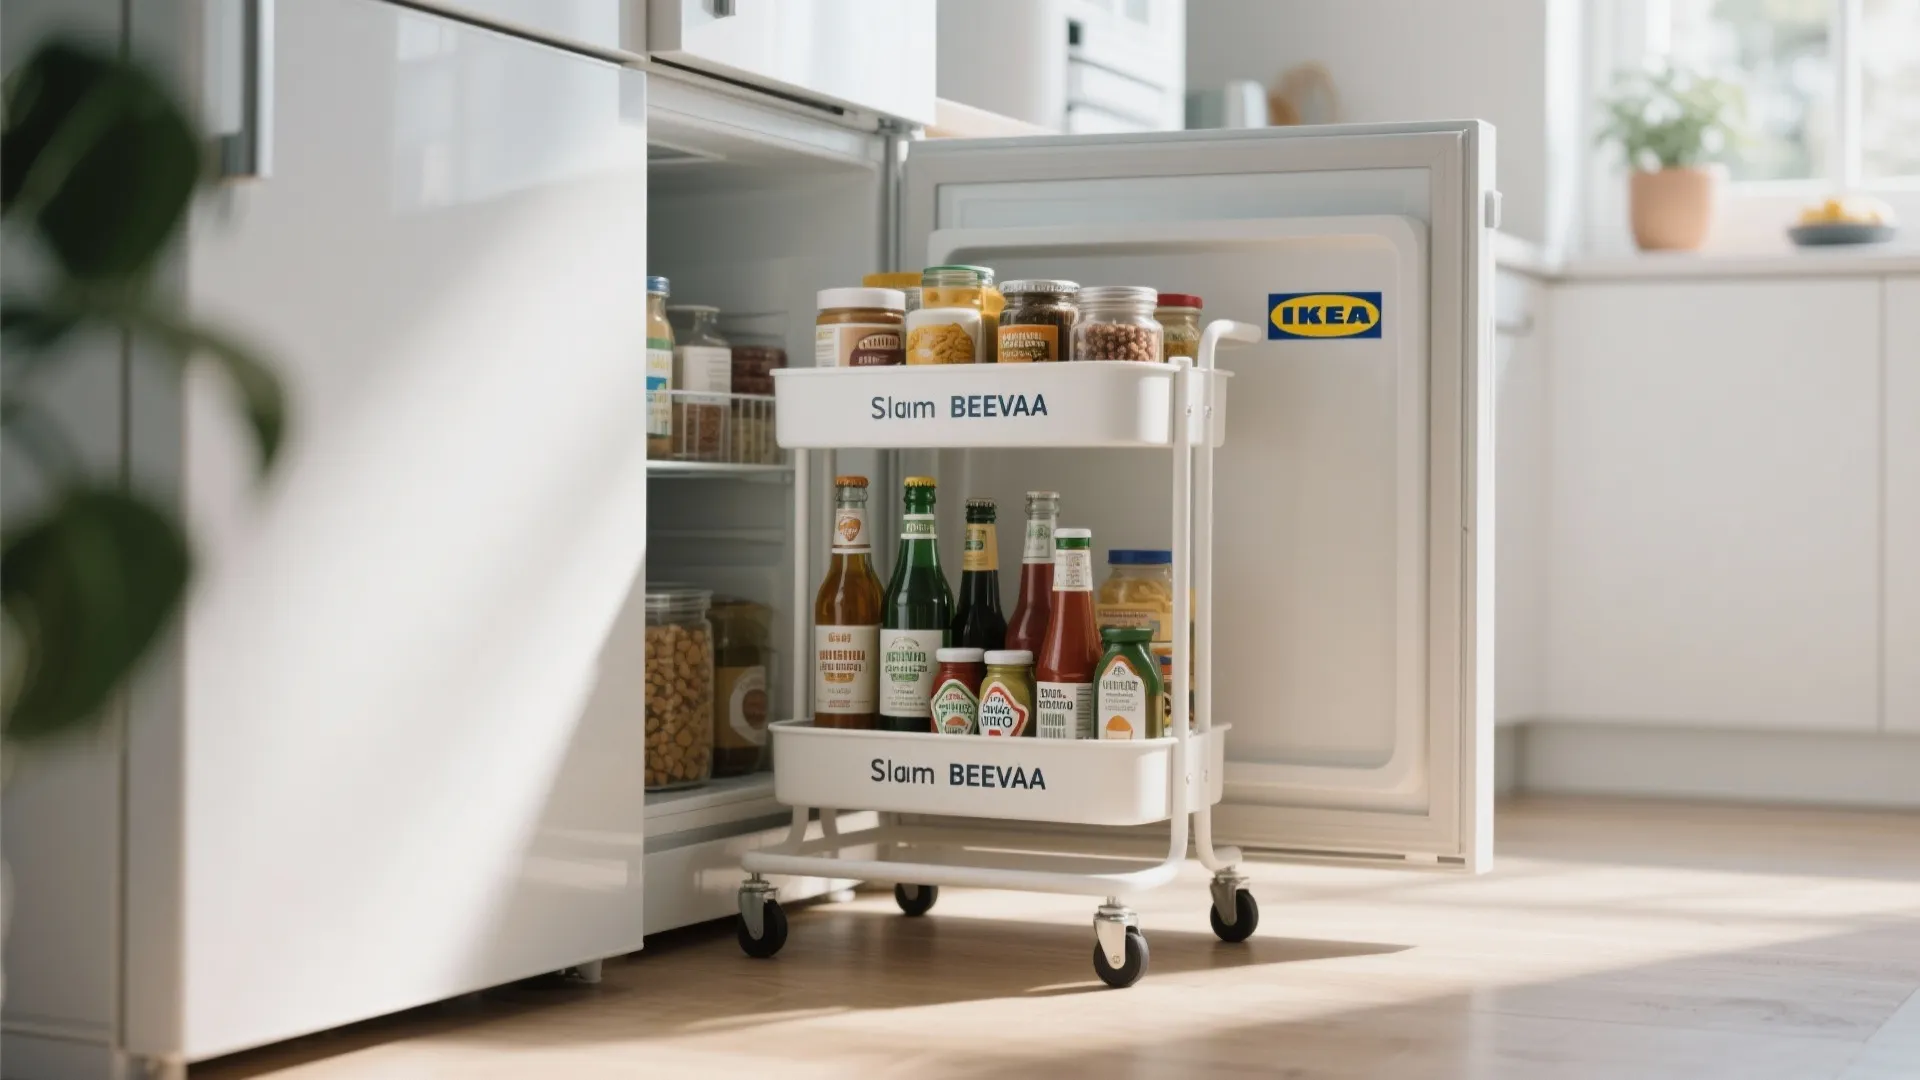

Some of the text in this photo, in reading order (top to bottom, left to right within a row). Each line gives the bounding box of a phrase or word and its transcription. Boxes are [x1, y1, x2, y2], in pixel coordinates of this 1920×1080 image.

[1282, 306, 1371, 325] IKEA
[950, 393, 1048, 419] BEEVAA
[949, 762, 1047, 791] BEEVAA
